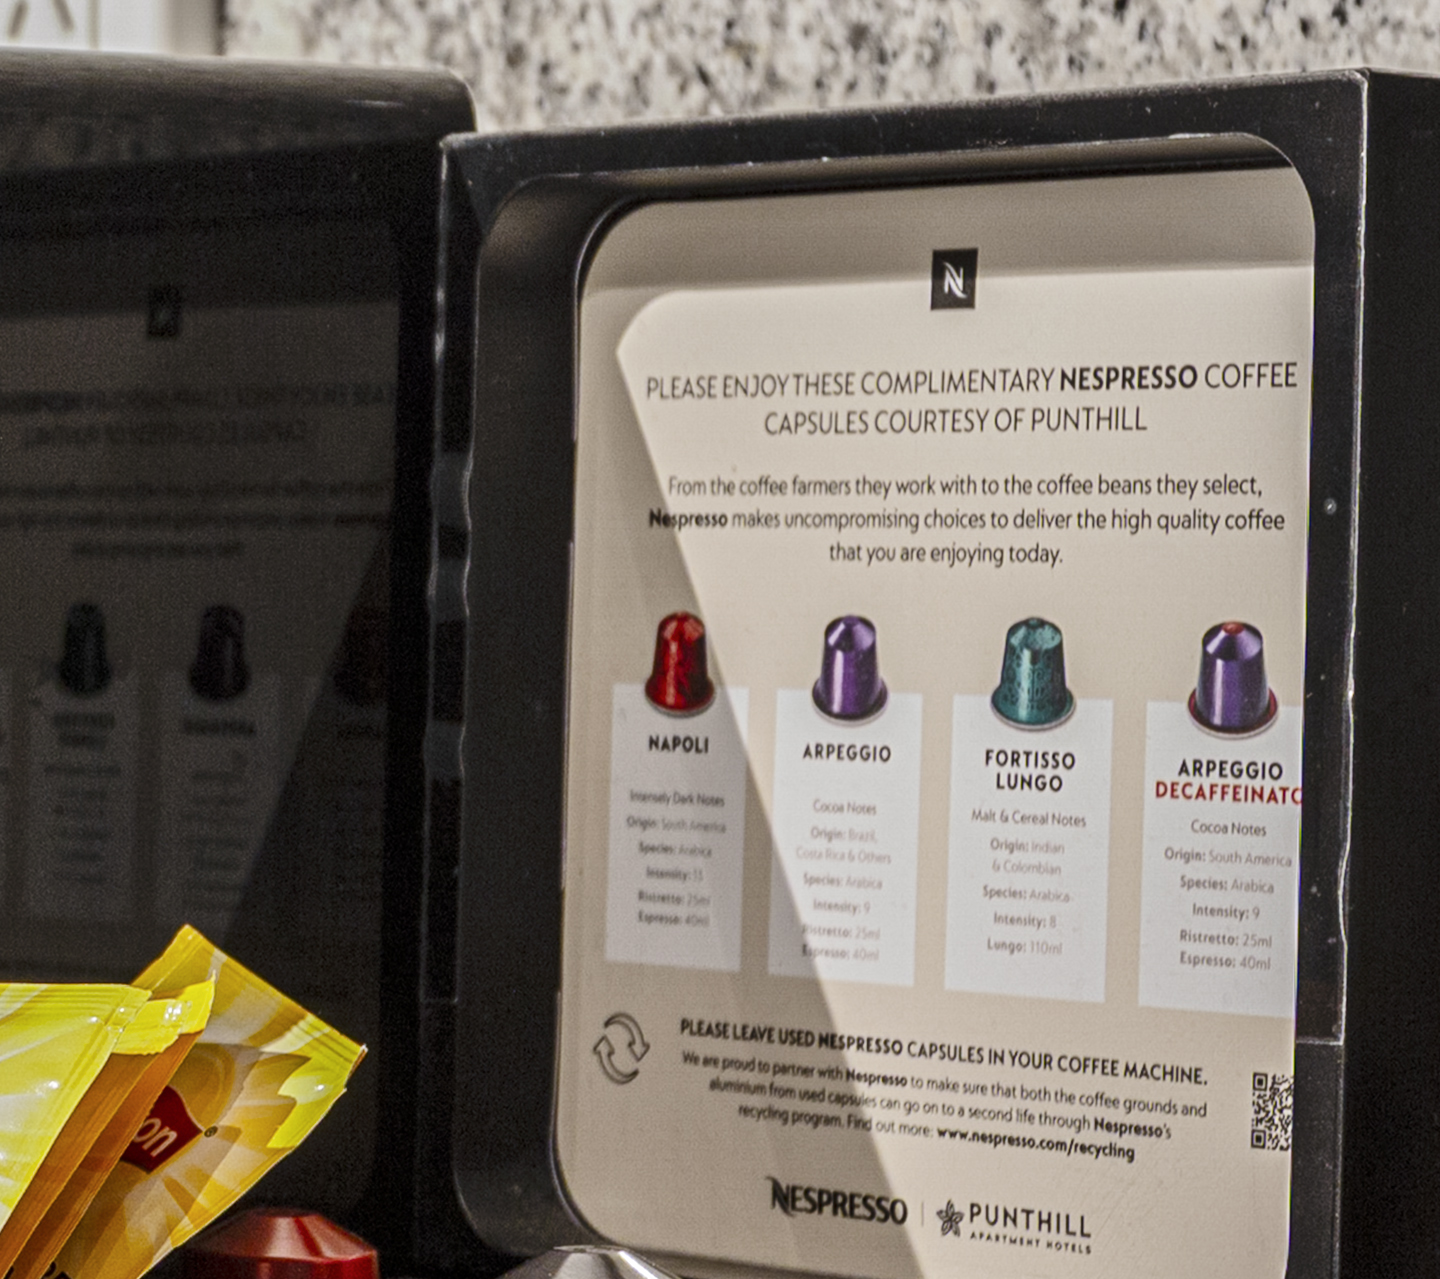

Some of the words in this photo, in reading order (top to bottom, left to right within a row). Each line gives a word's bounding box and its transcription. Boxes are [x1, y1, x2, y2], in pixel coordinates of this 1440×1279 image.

[647, 375, 717, 400] PLEASE
[723, 374, 789, 398] ENJOY
[793, 372, 855, 396] THESE
[861, 368, 1055, 395] COMPLIMENTARY
[1060, 365, 1198, 391] NESPRESSO
[1205, 362, 1297, 389] COFFEE
[764, 410, 869, 436] CAPSULES
[874, 408, 989, 434] COURTESY
[994, 408, 1025, 432] OF
[1031, 406, 1147, 432] PUNTHILL
[668, 475, 706, 496] From
[710, 476, 735, 496] the
[739, 475, 788, 496] coffee
[792, 475, 851, 496] farmers
[855, 475, 892, 500] they
[896, 475, 935, 495] work
[940, 475, 977, 495] with
[982, 478, 999, 495] to
[1004, 474, 1032, 495] the
[1037, 473, 1093, 495] coffee
[1098, 474, 1152, 495] beans
[1157, 474, 1198, 500] they
[1203, 473, 1262, 497] select,
[649, 508, 728, 530] Nespresso
[732, 509, 780, 528] makes
[785, 508, 919, 535] uncompromising
[924, 508, 986, 529] choices
[991, 512, 1009, 529] to
[1013, 508, 1072, 529] deliver
[1077, 509, 1106, 529] the
[1112, 509, 1152, 535] high
[1157, 509, 1221, 535] quality
[1225, 508, 1285, 530] coffee
[830, 542, 862, 561] that
[866, 546, 896, 567] you
[900, 547, 926, 562] are
[930, 542, 1004, 568] enjoying
[1009, 542, 1062, 568] today.
[649, 735, 709, 754] NAPOLI
[803, 743, 891, 763] ARPEGGIO
[985, 749, 1075, 770] FORTISSO
[1178, 759, 1283, 781] ARPEGGIO
[996, 773, 1063, 792] LUNGO
[813, 799, 844, 813] Cocoa
[847, 802, 877, 815] Notes
[971, 809, 996, 822] Malt
[1000, 809, 1009, 823] &
[1012, 810, 1049, 825] Cereal
[1051, 813, 1086, 828] Notes
[1191, 819, 1228, 834] Cocoa
[1231, 822, 1267, 837] Notes
[990, 837, 1028, 855] Origin:
[1031, 841, 1065, 854] Indian
[1164, 846, 1206, 864] Origin:
[1209, 849, 1242, 864] South
[1245, 852, 1292, 867] America
[983, 884, 1026, 900] Species:
[1029, 889, 1071, 903] Arabica
[1180, 875, 1227, 891] Species:
[1231, 878, 1274, 894] Arabica
[1193, 903, 1249, 922] Intensity:
[1252, 906, 1260, 919] 9
[1180, 929, 1238, 946] Ristretto:
[1243, 933, 1272, 948] 25ml
[1180, 950, 1235, 968] Espresso:
[1239, 955, 1271, 970] 40ml
[680, 1018, 729, 1039] PLEASE
[733, 1024, 775, 1044] LEAVE
[778, 1028, 815, 1047] USED
[818, 1033, 903, 1055] NESPRESSO
[907, 1041, 984, 1064] CAPSULES
[989, 1048, 1005, 1065] IN
[1009, 1050, 1053, 1070] YOUR
[1057, 1055, 1119, 1077] COFFEE
[1124, 1062, 1207, 1085] MACHINE.
[682, 1051, 700, 1066] We
[702, 1056, 719, 1068] are
[721, 1057, 756, 1072] proud
[758, 1060, 773, 1073] to
[772, 1063, 815, 1078] partner
[817, 1066, 843, 1080] with
[846, 1069, 907, 1087] Nespresso
[910, 1076, 924, 1089] to
[927, 1077, 959, 1093] make
[963, 1082, 988, 1096] sure
[991, 1082, 1016, 1099] that
[1020, 1084, 1051, 1101] both
[1054, 1088, 1076, 1105] the
[1079, 1092, 1120, 1109] coffee
[1123, 1099, 1178, 1115] grounds
[1181, 1102, 1207, 1118] and
[709, 1078, 767, 1095] aluminium
[769, 1081, 796, 1098] from
[799, 1088, 825, 1103] used
[828, 1092, 876, 1107] capsules
[880, 1098, 900, 1110] can
[903, 1101, 920, 1116] go
[923, 1103, 938, 1114] on
[942, 1103, 955, 1116] to
[958, 1106, 965, 1117] a
[968, 1107, 1013, 1122] second
[1016, 1108, 1035, 1125] life
[1039, 1111, 1090, 1134] through
[1094, 1117, 1171, 1139] Nespresso's
[738, 1105, 792, 1126] recycling
[791, 1111, 842, 1129] program.
[847, 1113, 871, 1132] Find
[876, 1121, 895, 1134] out
[899, 1124, 931, 1137] more:
[937, 1128, 1135, 1164] www.nespresso.com/recycling
[767, 1176, 908, 1225] NESPRESSO
[970, 1203, 1091, 1238] PUNTHILL
[970, 1232, 1040, 1247] APARTMENT
[1046, 1241, 1091, 1255] HOTELS
